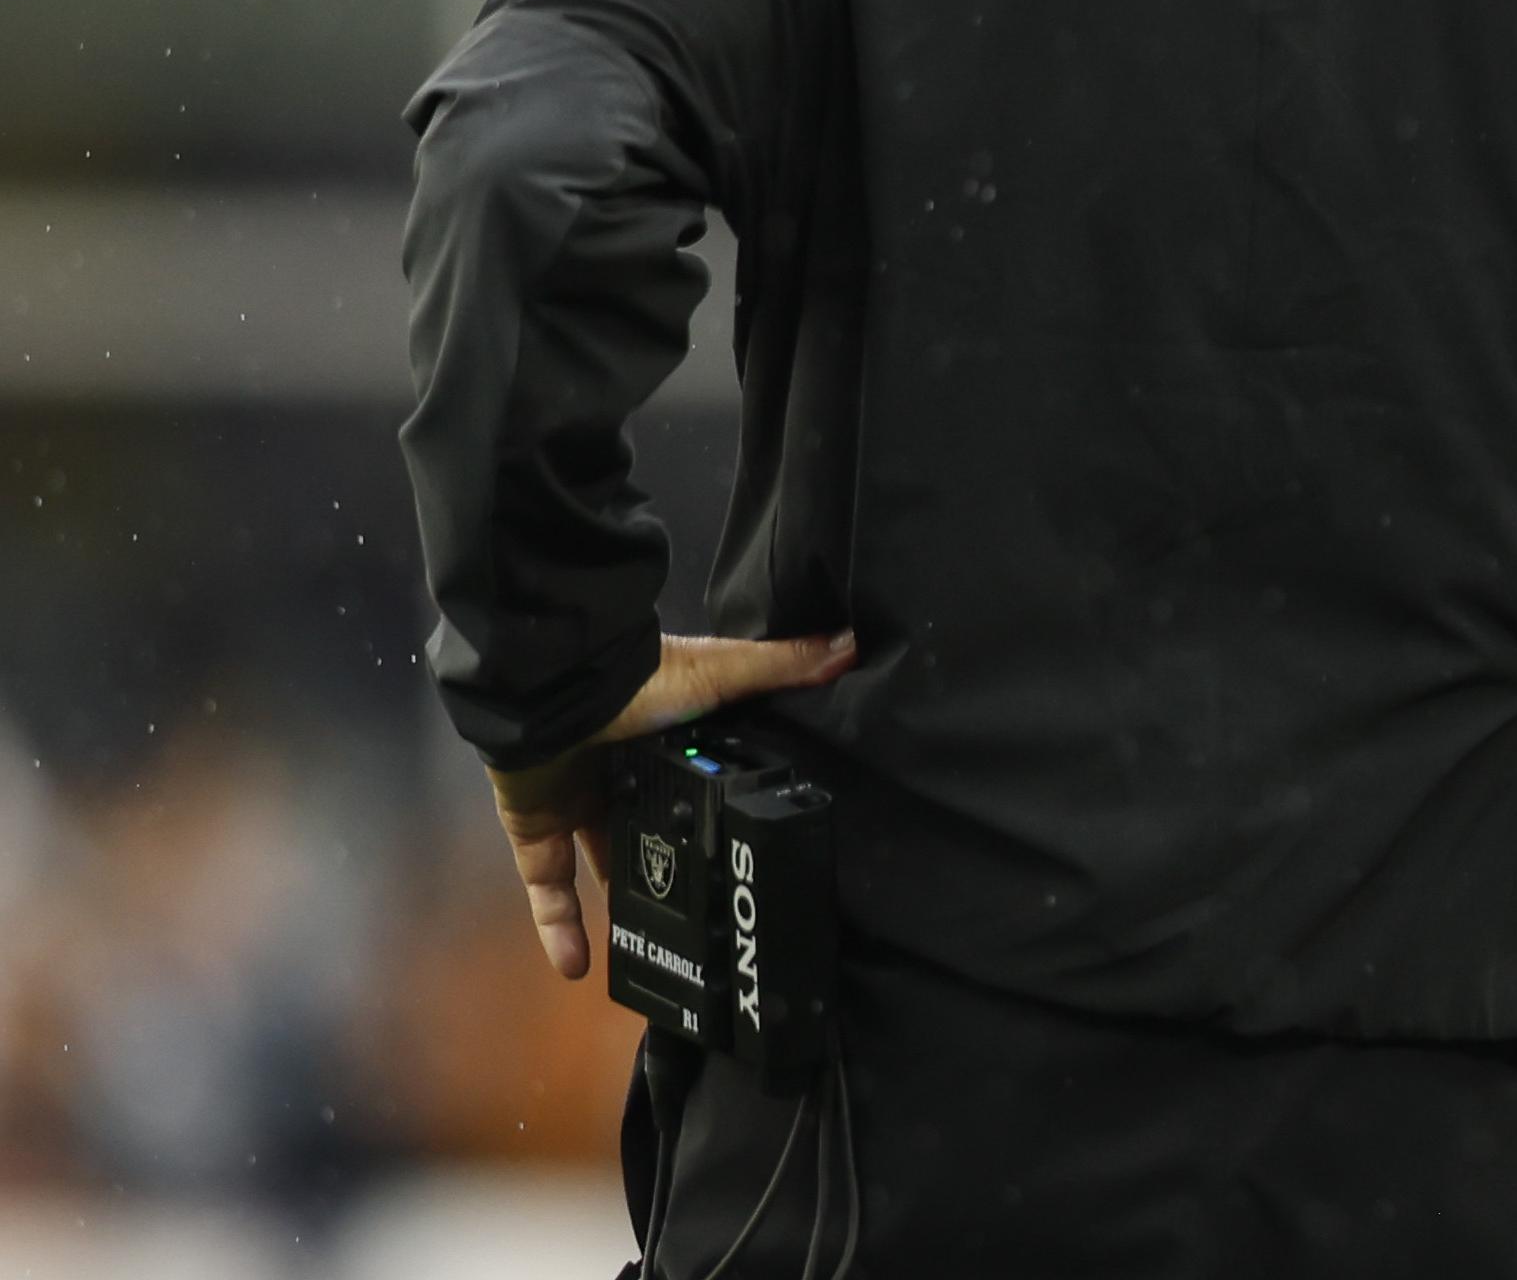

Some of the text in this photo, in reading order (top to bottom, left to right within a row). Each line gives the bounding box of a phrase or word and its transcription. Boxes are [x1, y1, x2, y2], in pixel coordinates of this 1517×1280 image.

[612, 923, 705, 988] PETE CARROLL
[731, 838, 760, 1033] SONY
[682, 1007, 699, 1034] R1
